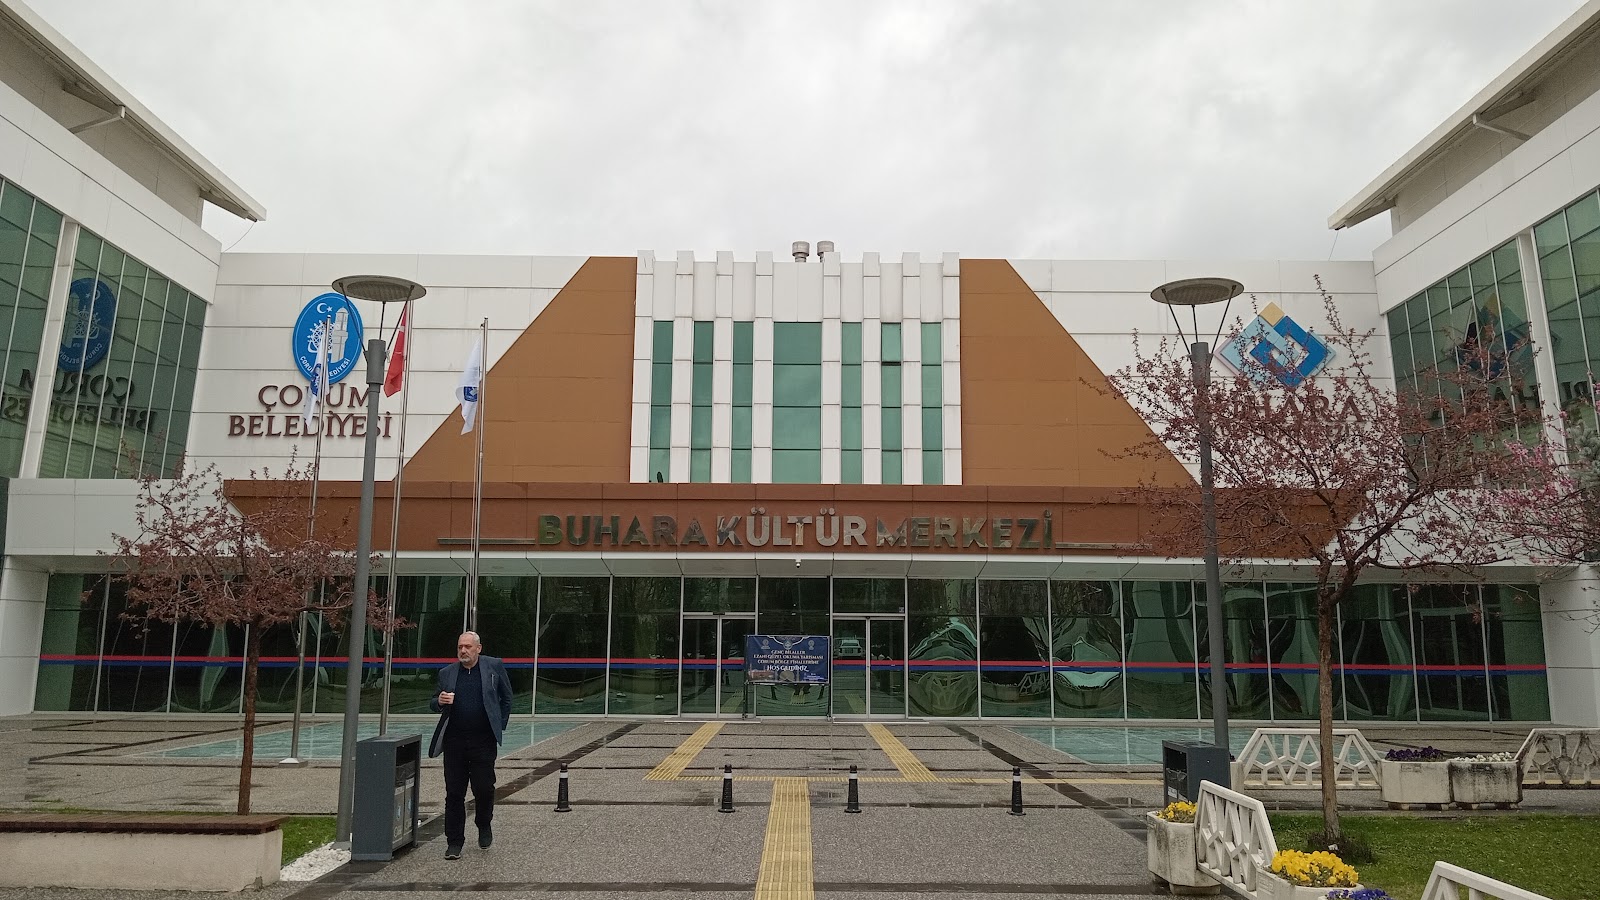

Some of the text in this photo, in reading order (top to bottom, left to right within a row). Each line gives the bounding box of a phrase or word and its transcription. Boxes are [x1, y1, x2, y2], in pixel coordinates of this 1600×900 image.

[323, 357, 351, 378] EDİYESİ
[228, 411, 392, 438] BELEDİYEİ
[538, 507, 1053, 548] BUHARA KÜLTÜR MERKEZİ
